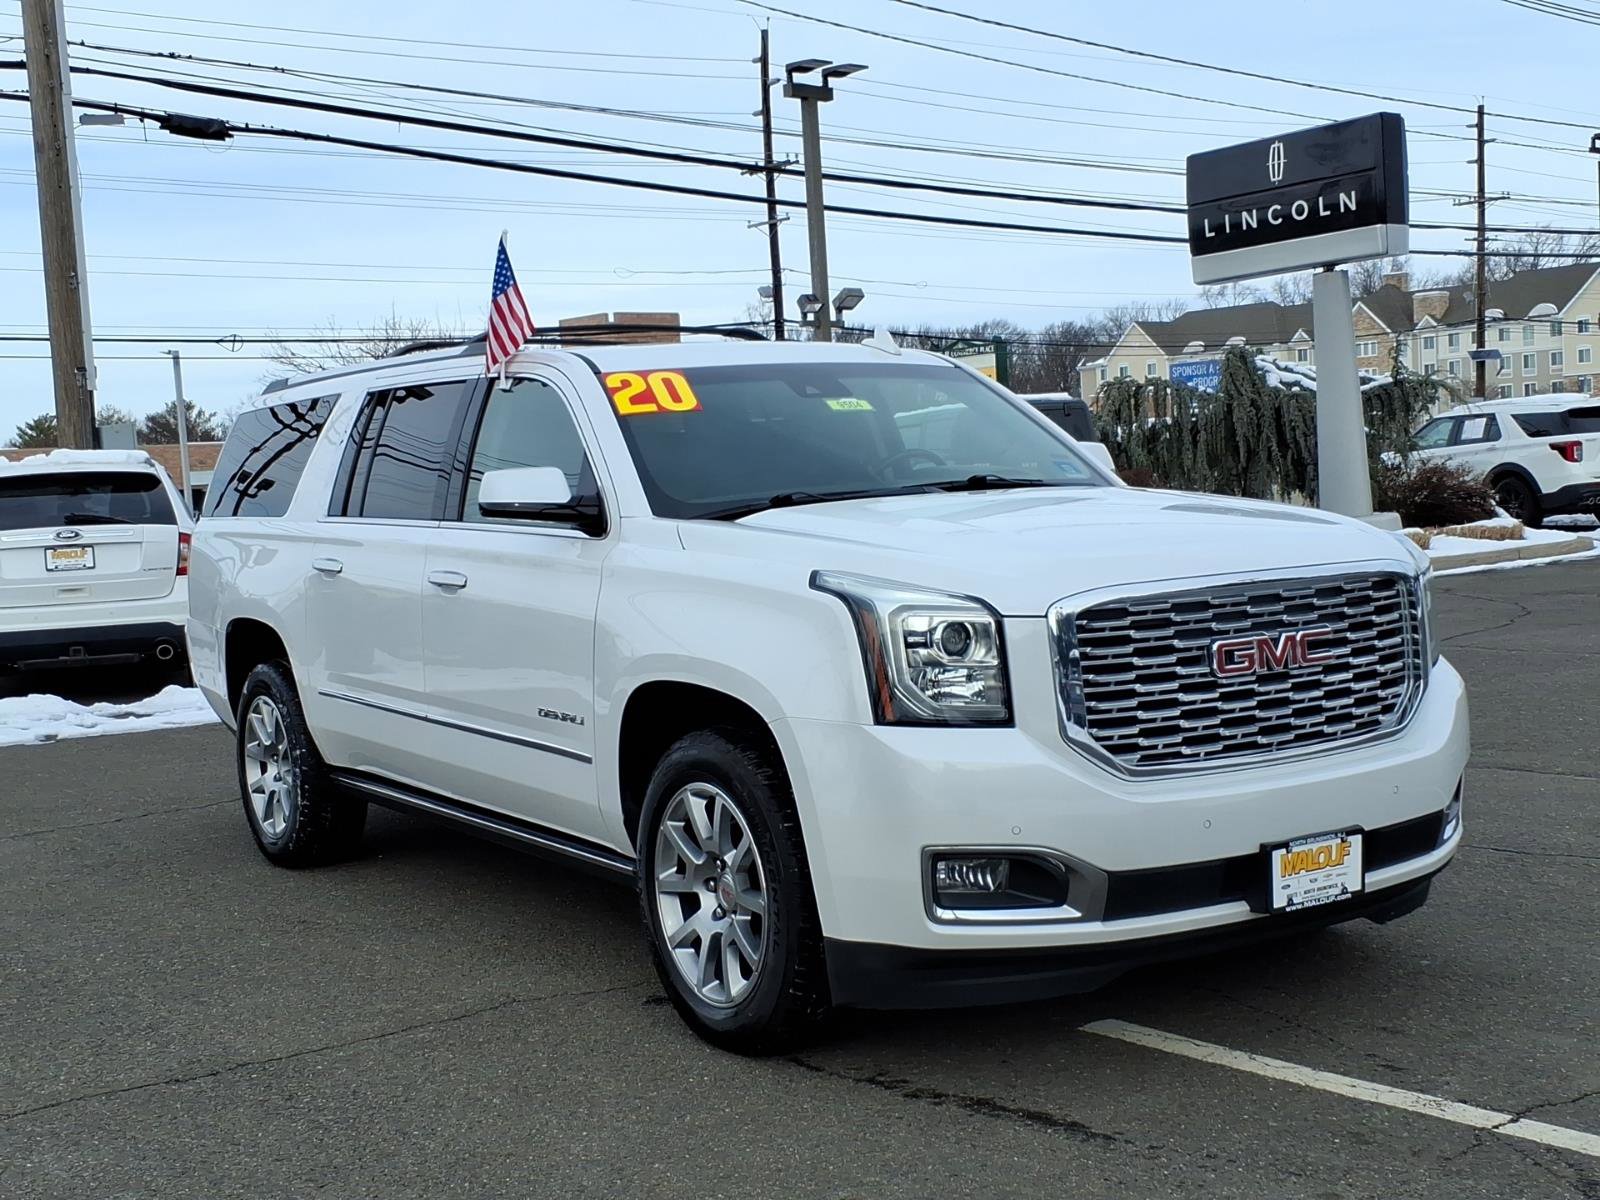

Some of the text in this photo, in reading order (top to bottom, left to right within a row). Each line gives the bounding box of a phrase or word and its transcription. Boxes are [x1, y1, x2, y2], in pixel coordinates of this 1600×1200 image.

[1203, 190, 1357, 238] LINCOLN
[1172, 364, 1207, 378] SPONSOR
[1208, 363, 1215, 374] A
[1192, 375, 1222, 388] PROGR
[605, 371, 699, 417] 20
[1212, 628, 1336, 678] GMC
[537, 707, 585, 726] DENALI
[1280, 841, 1352, 878] MALOUF
[1285, 893, 1352, 912] www.MALOUF.com
